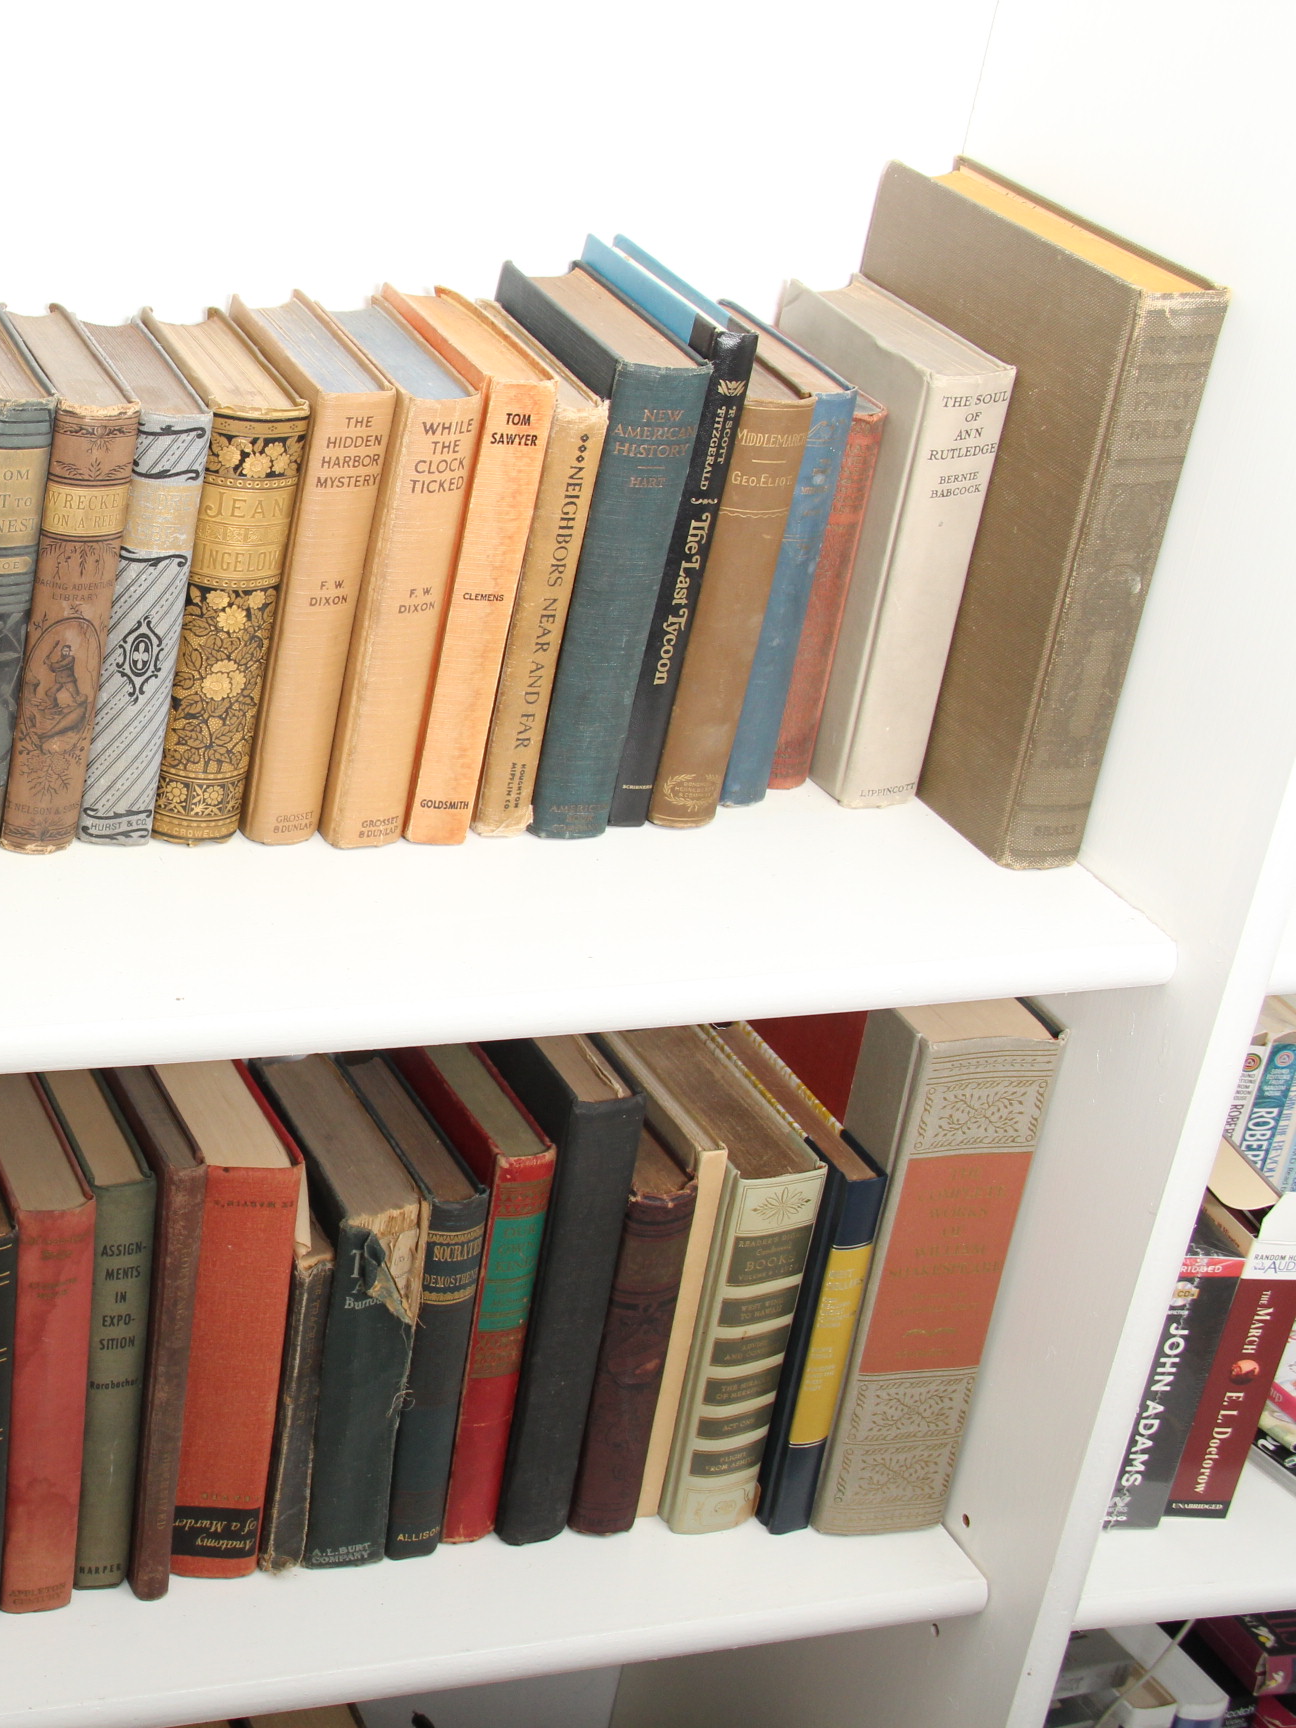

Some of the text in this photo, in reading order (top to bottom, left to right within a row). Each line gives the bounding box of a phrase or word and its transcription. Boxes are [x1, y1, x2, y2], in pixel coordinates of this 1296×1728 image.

[942, 391, 1008, 408] THE SOUL
[345, 416, 374, 428] THE
[505, 413, 530, 426] TOM
[642, 409, 684, 422] NEW
[965, 411, 981, 422] OF
[422, 419, 474, 436] WHILE
[612, 424, 697, 440] AMERICAN
[954, 427, 984, 442] ANN
[326, 434, 382, 449] HIDDEN
[490, 432, 538, 446] SAWYER
[431, 440, 460, 454] THE
[614, 441, 689, 458] HISTORY
[927, 443, 997, 461] RUTLEDGE
[321, 454, 380, 469] HARBOR
[414, 456, 465, 474] CLOCK
[316, 473, 380, 488] MYSTERY
[410, 476, 464, 494] TICKED
[629, 476, 666, 488] HART
[938, 472, 979, 485] BERNIE
[930, 485, 981, 499] BABCOCK
[205, 491, 286, 519] JEAN
[310, 594, 348, 606] DIXON
[463, 592, 504, 601] CLEMENS
[652, 511, 711, 686] The Last Tycoon
[515, 465, 584, 750] NEIGHBORS NEAR AND FAR
[420, 799, 469, 809] GOLDSMITH
[126, 819, 134, 829] &
[101, 1243, 147, 1258] ASSIGN-
[105, 1267, 141, 1280] MENTS
[114, 1292, 127, 1303] IN
[102, 1313, 135, 1328] EXPO-
[1242, 1291, 1274, 1353] THE MARCH
[99, 1335, 135, 1350] SITION
[1121, 1324, 1188, 1486] JOHN ADAMS
[1194, 1391, 1244, 1494] E. L. Doctorow
[173, 1519, 257, 1534] of a Murder
[196, 1535, 254, 1552] Anatomy
